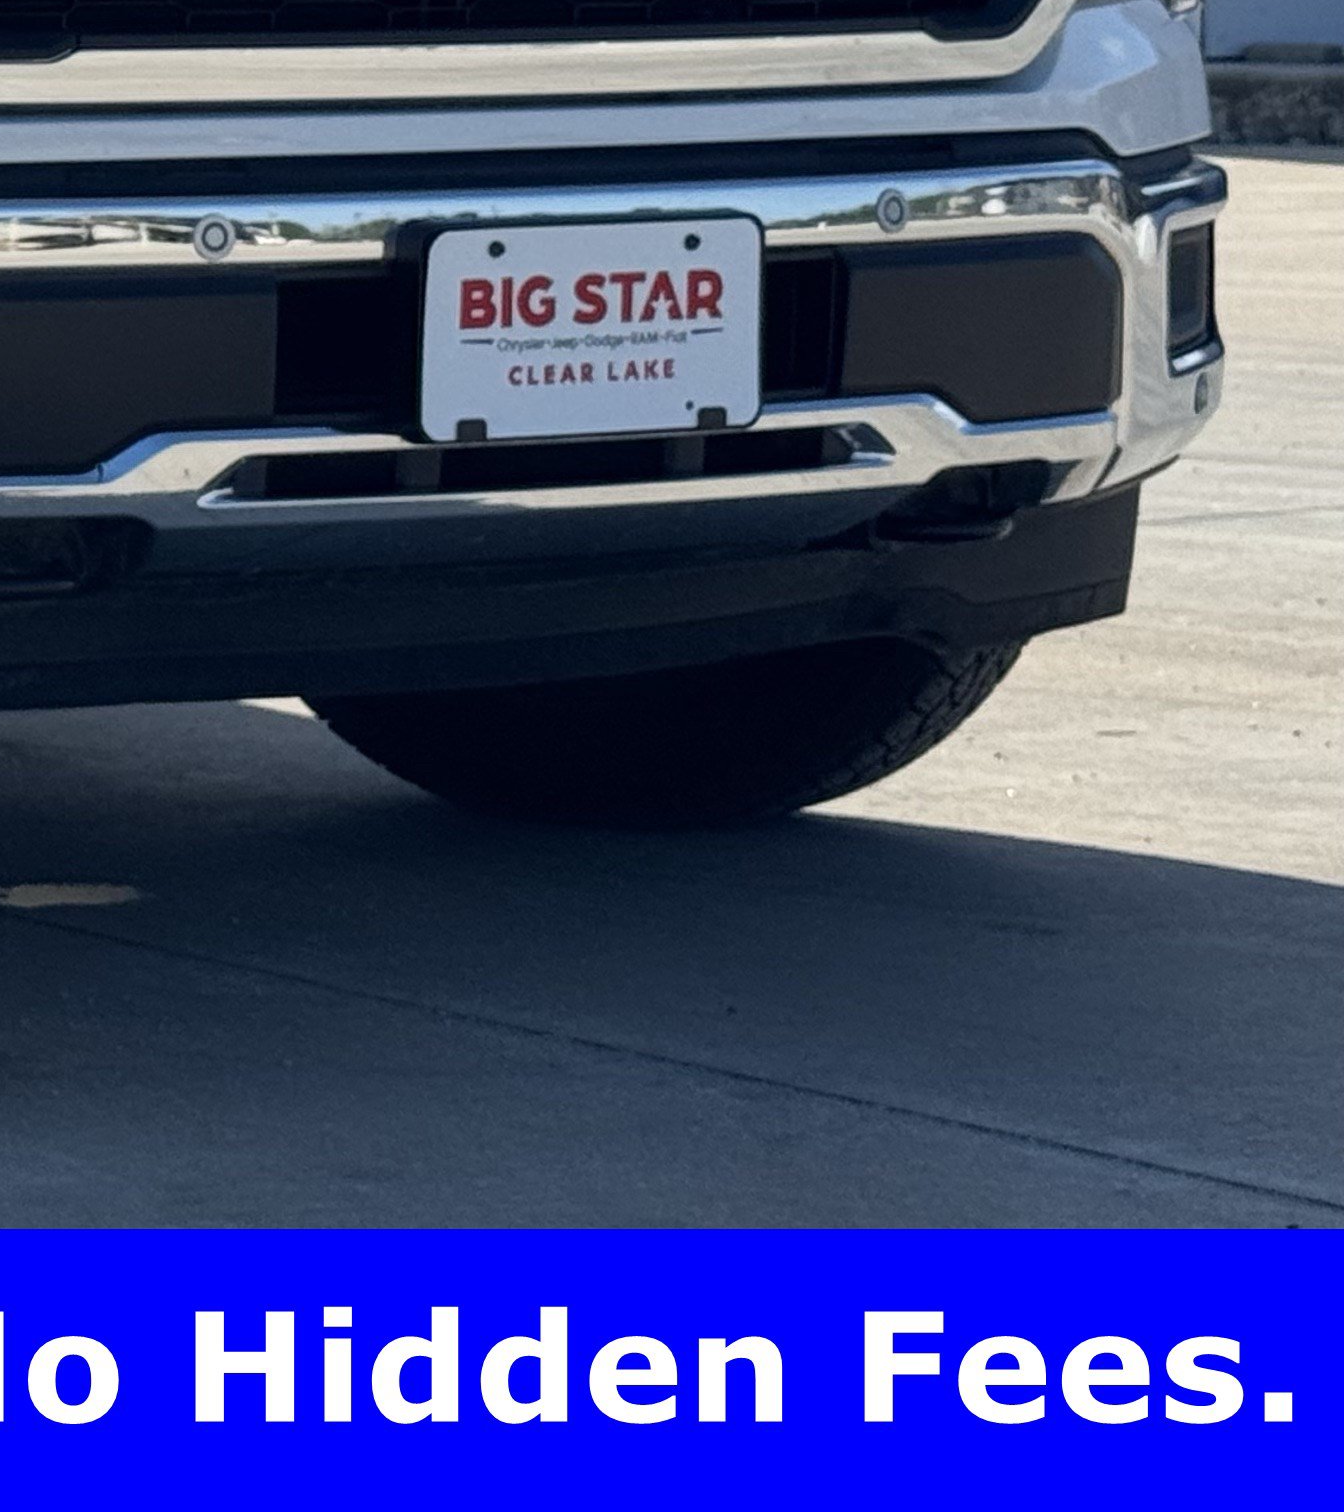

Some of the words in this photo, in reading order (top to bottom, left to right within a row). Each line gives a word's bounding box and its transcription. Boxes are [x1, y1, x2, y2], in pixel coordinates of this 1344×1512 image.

[459, 276, 556, 330] BIG
[573, 269, 724, 324] STAR
[508, 362, 594, 386] CLEAR
[607, 358, 676, 382] LAKE
